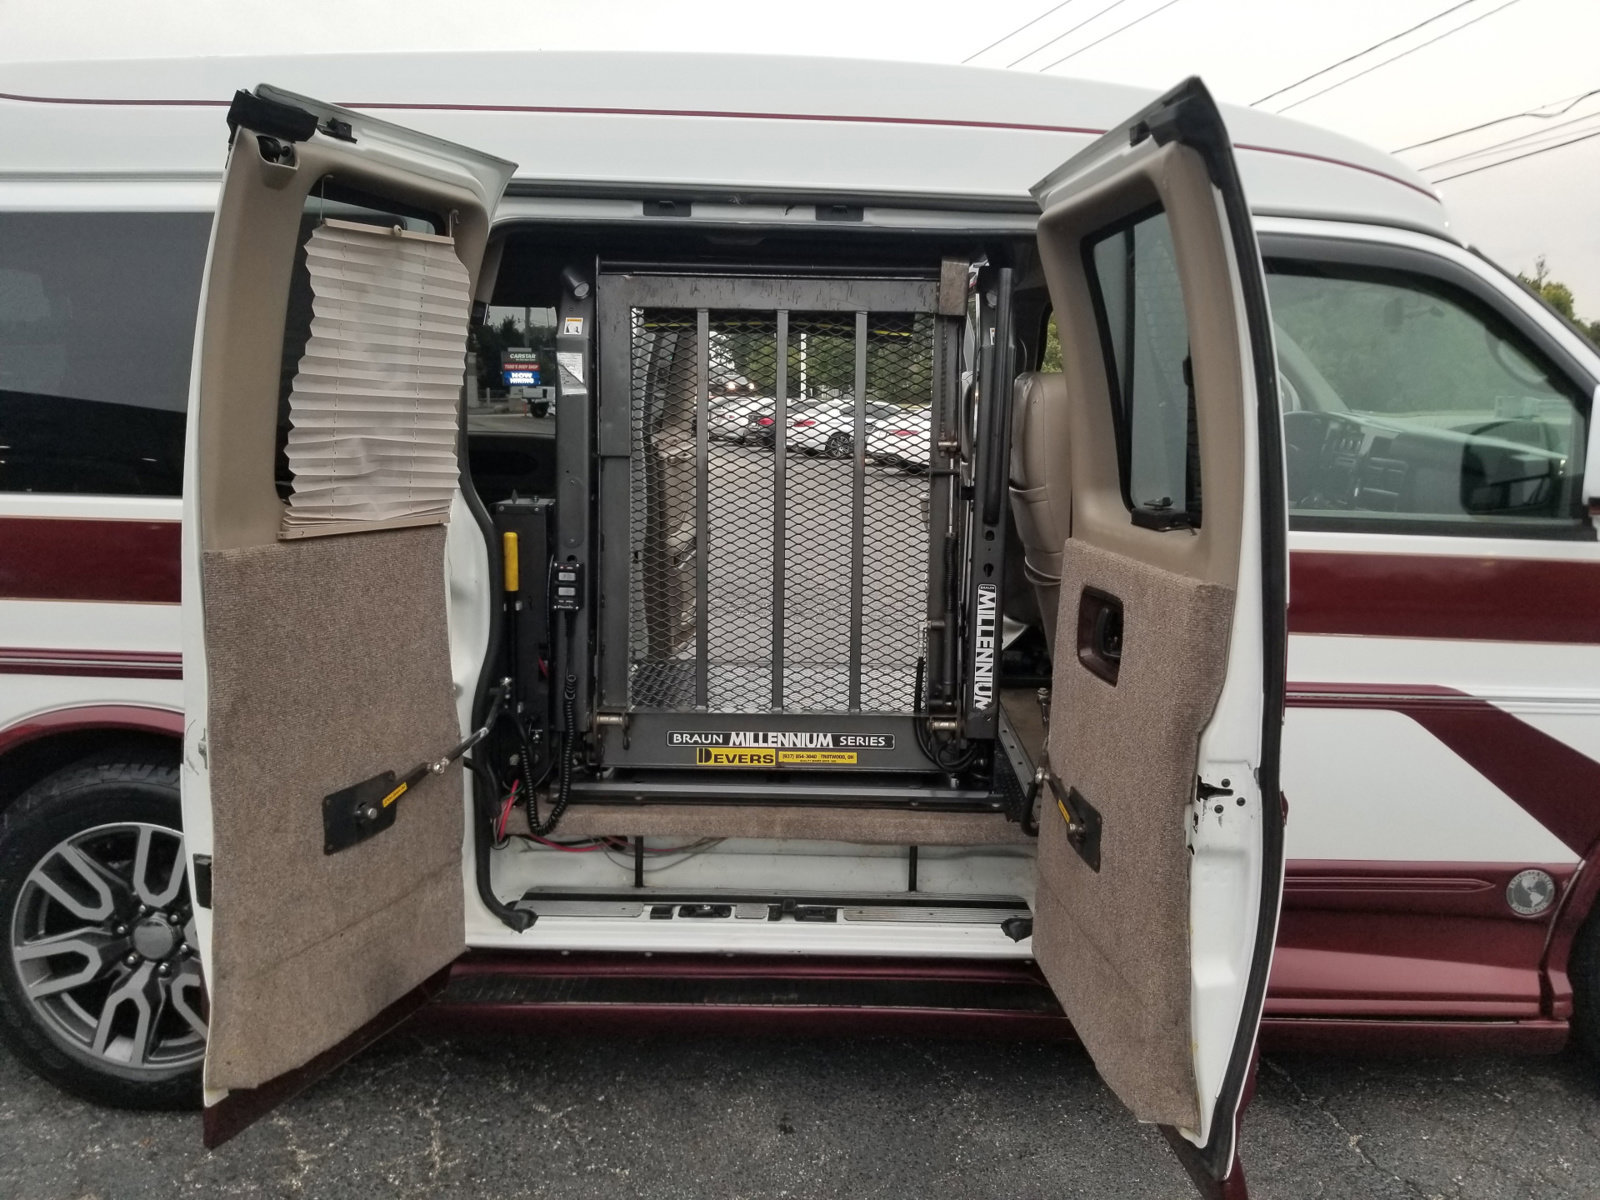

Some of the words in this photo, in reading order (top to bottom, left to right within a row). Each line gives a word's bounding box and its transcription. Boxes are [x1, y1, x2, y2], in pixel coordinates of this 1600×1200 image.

[974, 589, 996, 711] MILLENNIUM
[673, 733, 724, 744] BRAUN
[729, 731, 833, 748] MILLENNIUM
[839, 736, 886, 746] SERIES
[698, 748, 774, 764] DEVERS
